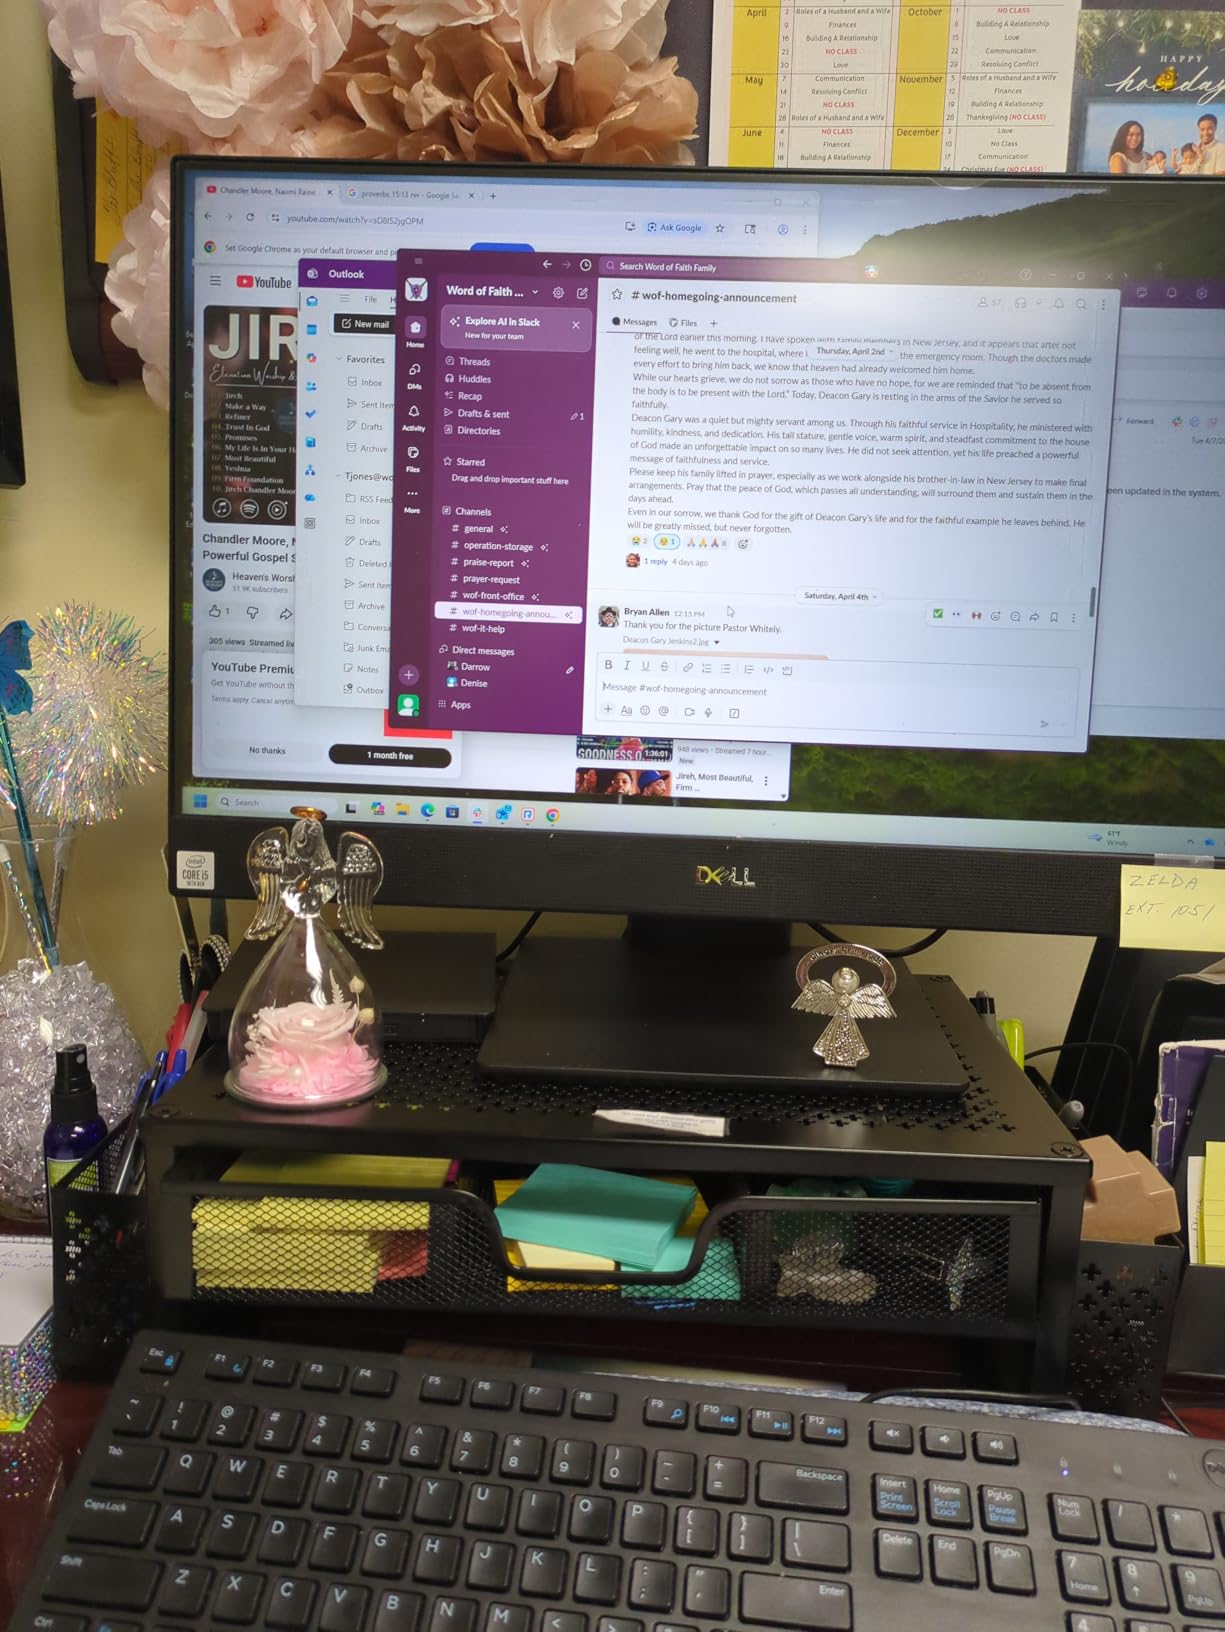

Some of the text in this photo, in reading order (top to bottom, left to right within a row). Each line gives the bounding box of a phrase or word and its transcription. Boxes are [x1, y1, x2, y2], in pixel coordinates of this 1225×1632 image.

[747, 9, 767, 17] April
[908, 8, 942, 16] October
[1160, 55, 1202, 63] HAPPY
[745, 76, 763, 85] May
[900, 75, 943, 84] November
[742, 129, 762, 137] June
[897, 129, 939, 137] December
[678, 224, 702, 233] Google
[620, 262, 716, 274] Search Word of Faith Family
[329, 270, 364, 279] Outlook
[255, 277, 292, 288] YouTube
[447, 285, 512, 296] Word of Faith
[642, 291, 797, 304] wof-homegoing-announcement
[354, 320, 389, 329] New mail
[465, 317, 540, 327] Explore AI in Slack
[623, 318, 657, 327] Messages
[681, 319, 697, 327] Files
[347, 355, 385, 364] Favorites
[459, 357, 490, 366] Threads
[362, 379, 382, 387] Inbox
[459, 375, 491, 383] Huddles
[458, 392, 482, 402] Recap
[458, 409, 482, 418] Drafts
[484, 410, 491, 418] &
[632, 414, 662, 422] Deacon
[664, 415, 683, 424] Gary
[709, 416, 729, 425] quiet
[731, 417, 744, 425] but
[747, 417, 774, 427] mighty
[807, 420, 834, 428] among
[458, 426, 500, 435] Directories
[457, 458, 485, 466] Starred
[630, 455, 770, 466] message of faithfulness and service.
[484, 475, 500, 483] drop
[501, 476, 534, 484] important
[456, 507, 492, 516] Channels
[464, 525, 493, 534] general
[627, 521, 641, 529] will
[643, 522, 652, 530] be
[654, 522, 682, 532] greatly
[683, 523, 711, 532] missed,
[714, 524, 727, 532] but
[753, 525, 792, 535] forgotten.
[203, 534, 289, 548] Chandler Moore,
[464, 542, 533, 552] operation-storage
[203, 551, 288, 564] Powerful Gospel
[463, 558, 514, 568] praise-report
[463, 575, 520, 585] prayer-request
[463, 592, 524, 601] wof-front-office
[804, 592, 836, 600] Saturday,
[358, 602, 385, 610] Archive
[624, 608, 670, 617] Bryan Allen
[462, 625, 505, 634] wof-it-help
[624, 620, 747, 632] Thank for picture Pastor
[452, 646, 514, 656] Direct messages
[461, 663, 490, 671] Darrow
[461, 679, 488, 688] Denise
[357, 686, 384, 694] Outbox
[451, 701, 471, 710] Apps
[263, 747, 286, 755] thanks
[373, 752, 413, 760] month free
[698, 773, 754, 783] Most Beautiful,
[235, 799, 259, 807] Search
[183, 870, 200, 880] CORE
[697, 865, 756, 887] DELL
[1129, 873, 1199, 890] ZELDA
[215, 1354, 227, 1362] F1
[429, 1376, 441, 1384] F5
[478, 1382, 490, 1390] F6
[528, 1387, 541, 1395] F7
[580, 1392, 592, 1400] F8
[704, 1405, 719, 1413] F10
[756, 1410, 771, 1419] F11
[809, 1416, 825, 1424] F12
[180, 1454, 192, 1468] Q
[229, 1459, 247, 1473] W
[277, 1465, 288, 1478] E
[796, 1469, 843, 1482] Backspace
[326, 1470, 338, 1483] R
[377, 1476, 388, 1489] T
[880, 1478, 906, 1489] Insert
[427, 1482, 438, 1495] Y
[933, 1485, 961, 1496] Home
[477, 1488, 489, 1500] U
[579, 1499, 592, 1512] O
[880, 1500, 913, 1511] Screen
[632, 1505, 643, 1517] P
[170, 1509, 183, 1523] A
[221, 1514, 235, 1528] S
[271, 1521, 285, 1534] D
[374, 1533, 387, 1547] G
[883, 1533, 913, 1545] Delete
[426, 1539, 439, 1552] H
[938, 1540, 957, 1550] End
[531, 1552, 544, 1565] K
[819, 1585, 846, 1596] Enter
